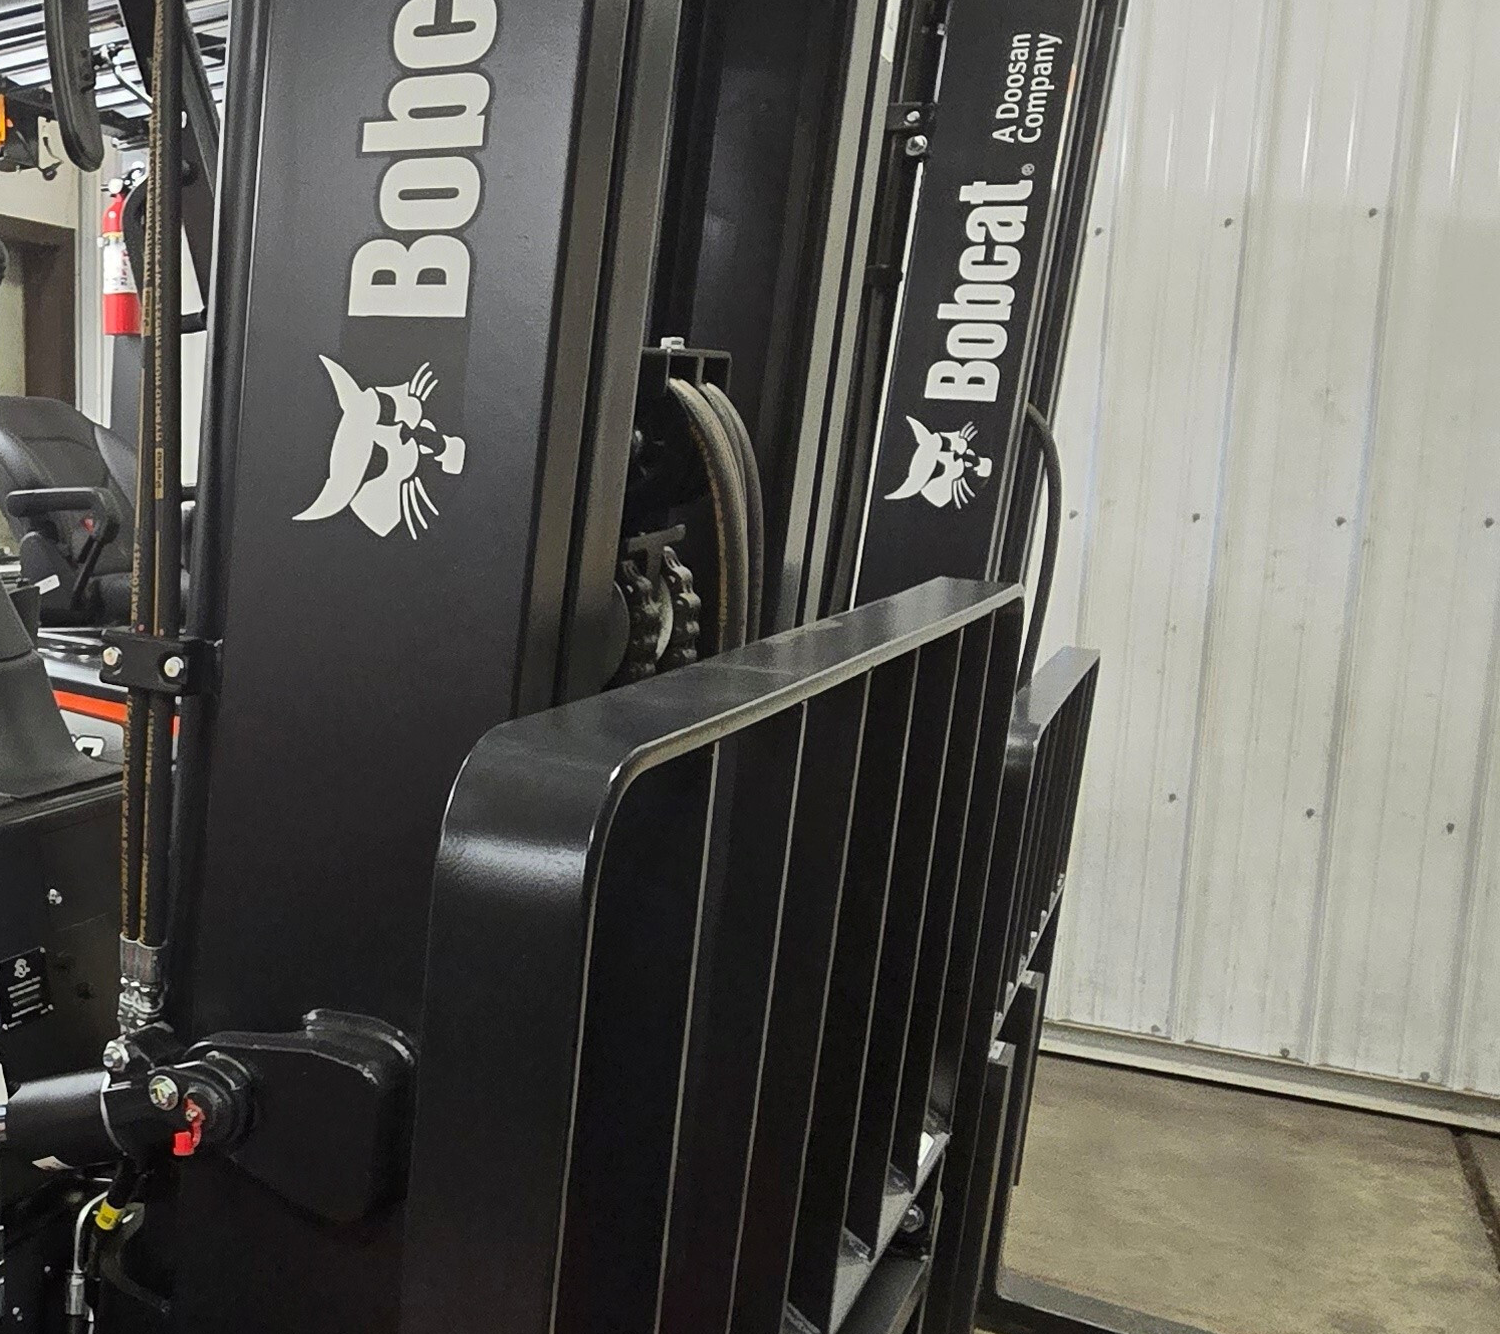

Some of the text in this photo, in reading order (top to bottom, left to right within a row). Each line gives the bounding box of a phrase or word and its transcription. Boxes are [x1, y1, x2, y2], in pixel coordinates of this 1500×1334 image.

[991, 32, 1032, 144] A Doosan
[1017, 32, 1062, 144] Company
[923, 179, 1034, 403] Bobcat
